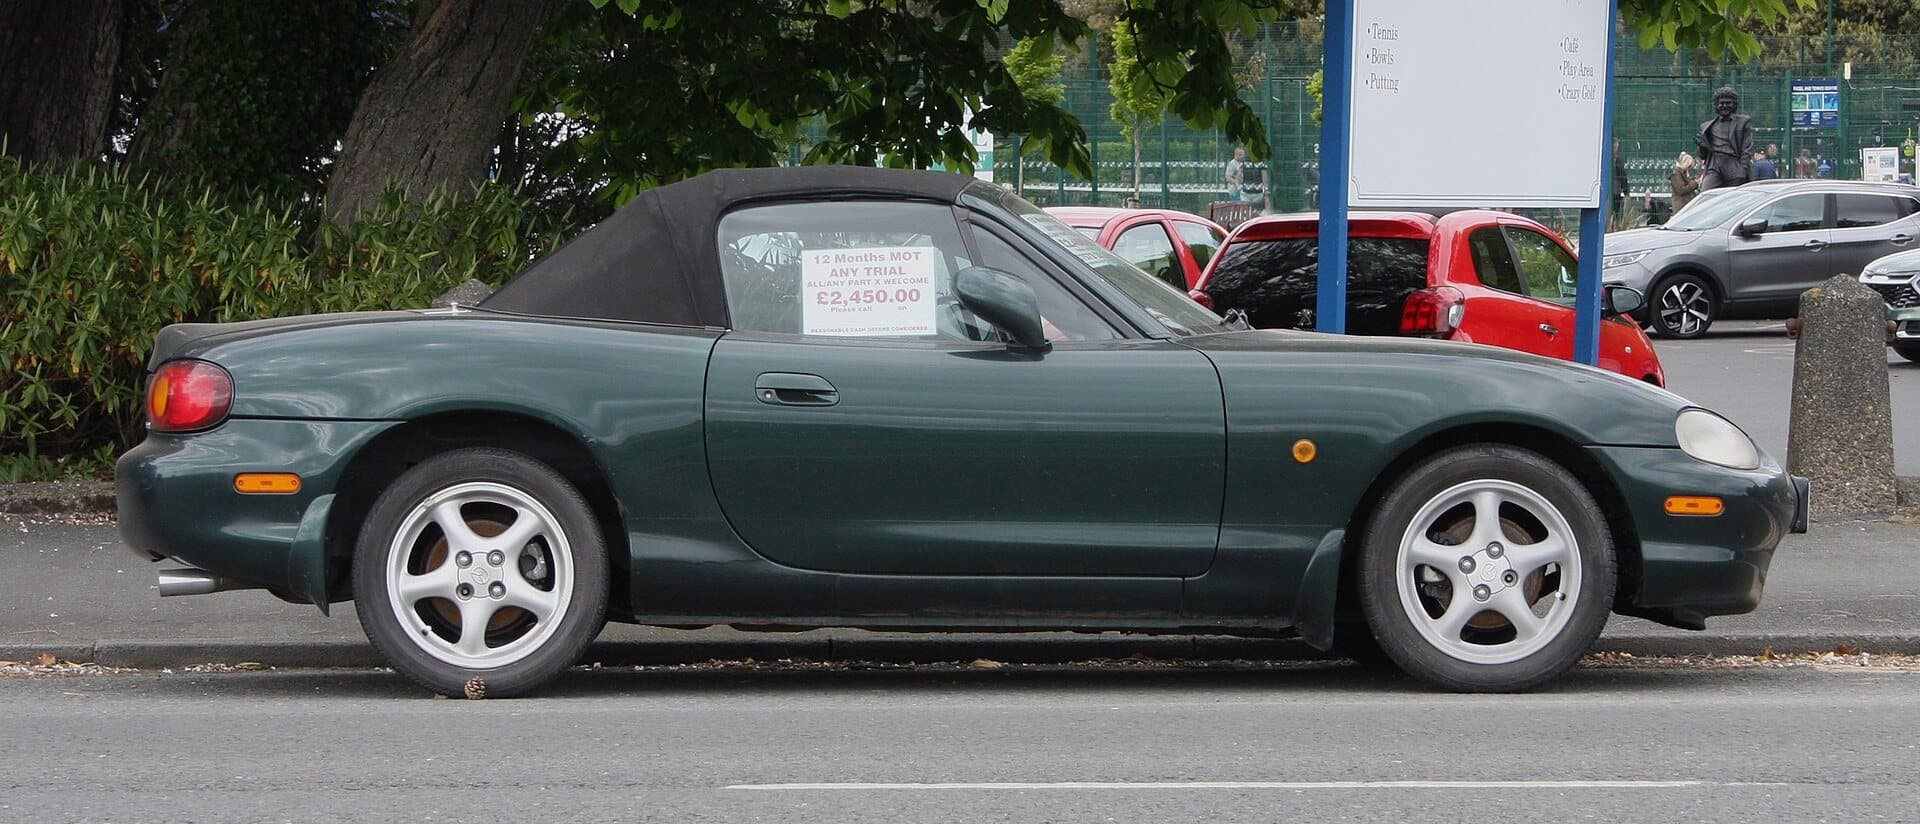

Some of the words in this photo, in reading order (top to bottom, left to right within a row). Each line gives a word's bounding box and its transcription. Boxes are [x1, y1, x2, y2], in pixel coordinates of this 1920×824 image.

[1371, 22, 1399, 41] Tennis
[1371, 47, 1394, 65] Bowls
[1562, 60, 1577, 79] Play
[1578, 61, 1594, 77] Area
[1370, 72, 1399, 94] Putting
[1561, 83, 1581, 103] Crazy
[1581, 84, 1597, 100] Golf
[814, 254, 831, 264] 12
[834, 252, 885, 263] Months
[889, 251, 922, 261] MOT
[829, 267, 859, 278] ANY
[863, 266, 907, 276] TRIAL
[806, 279, 846, 288] ALL/ANY
[874, 278, 881, 286] X
[882, 277, 929, 285] WELCOME
[816, 288, 922, 307] £2,450.00
